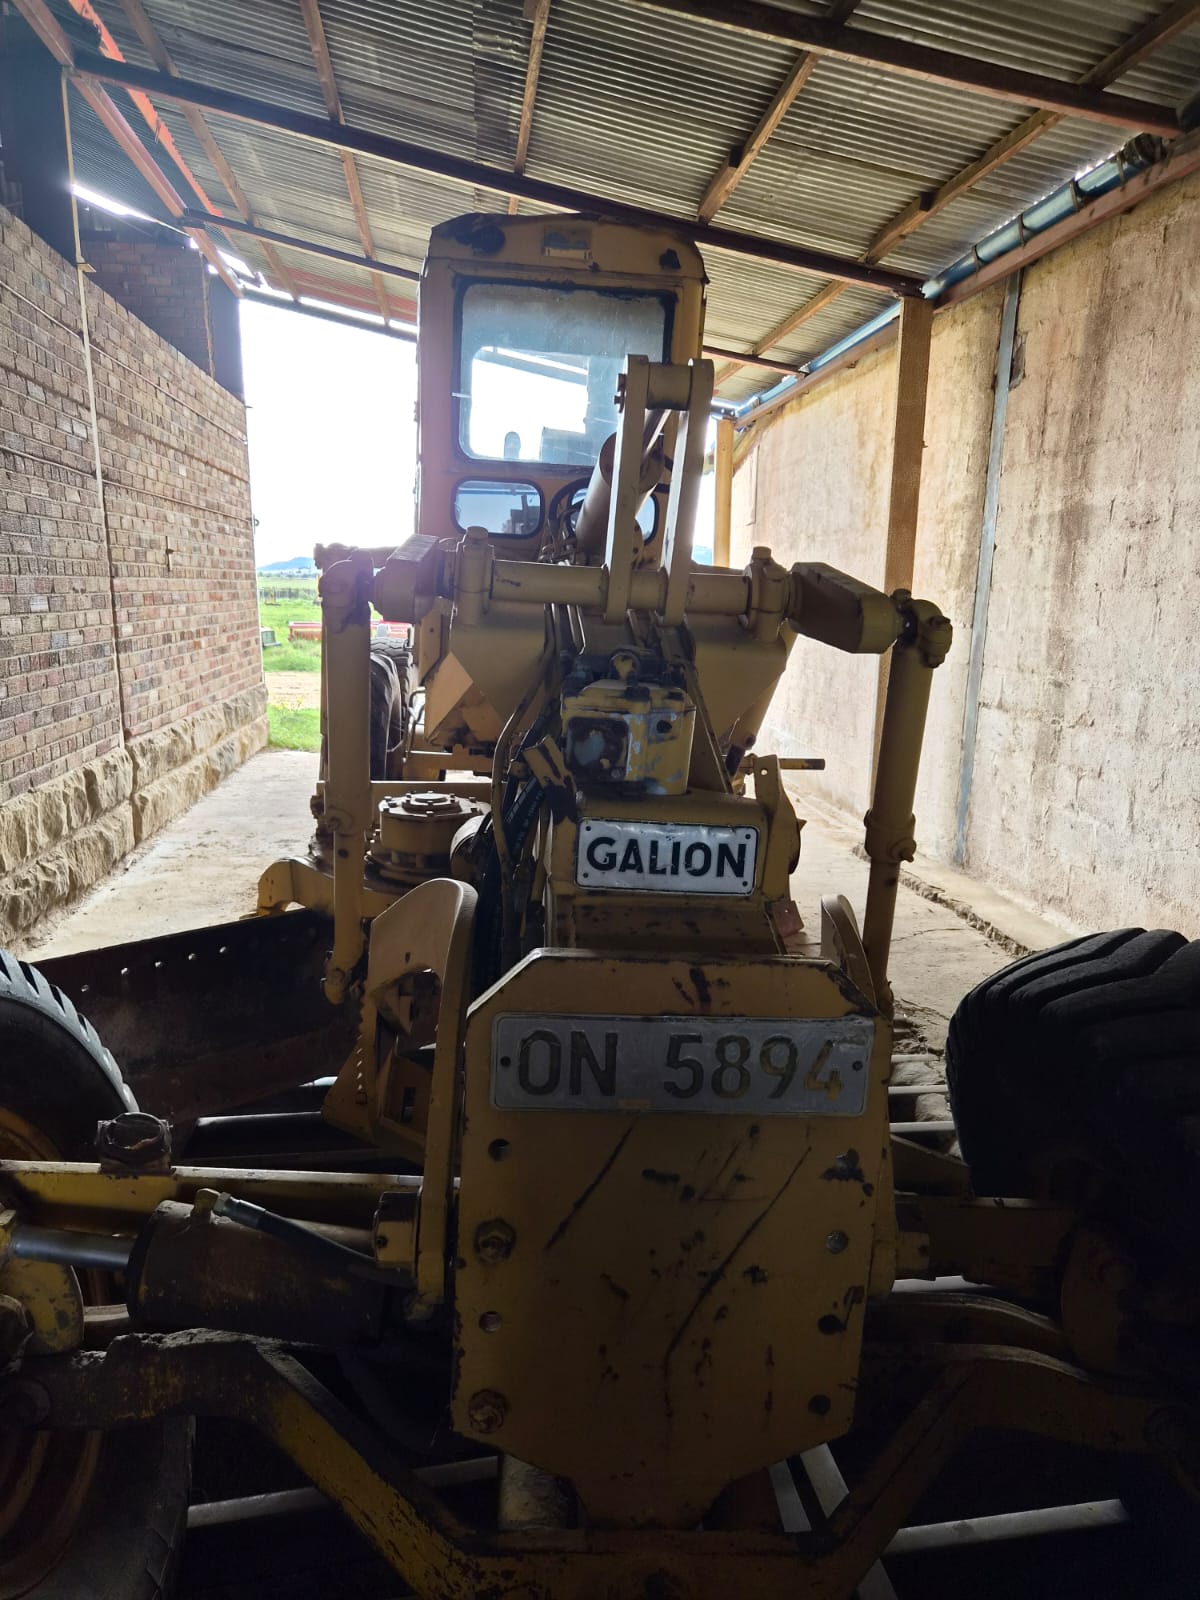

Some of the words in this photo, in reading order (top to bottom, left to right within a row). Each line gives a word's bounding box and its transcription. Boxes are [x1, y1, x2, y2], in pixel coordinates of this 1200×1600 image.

[586, 836, 747, 878] GALION
[517, 1029, 618, 1097] ON
[663, 1033, 843, 1100] 5894
